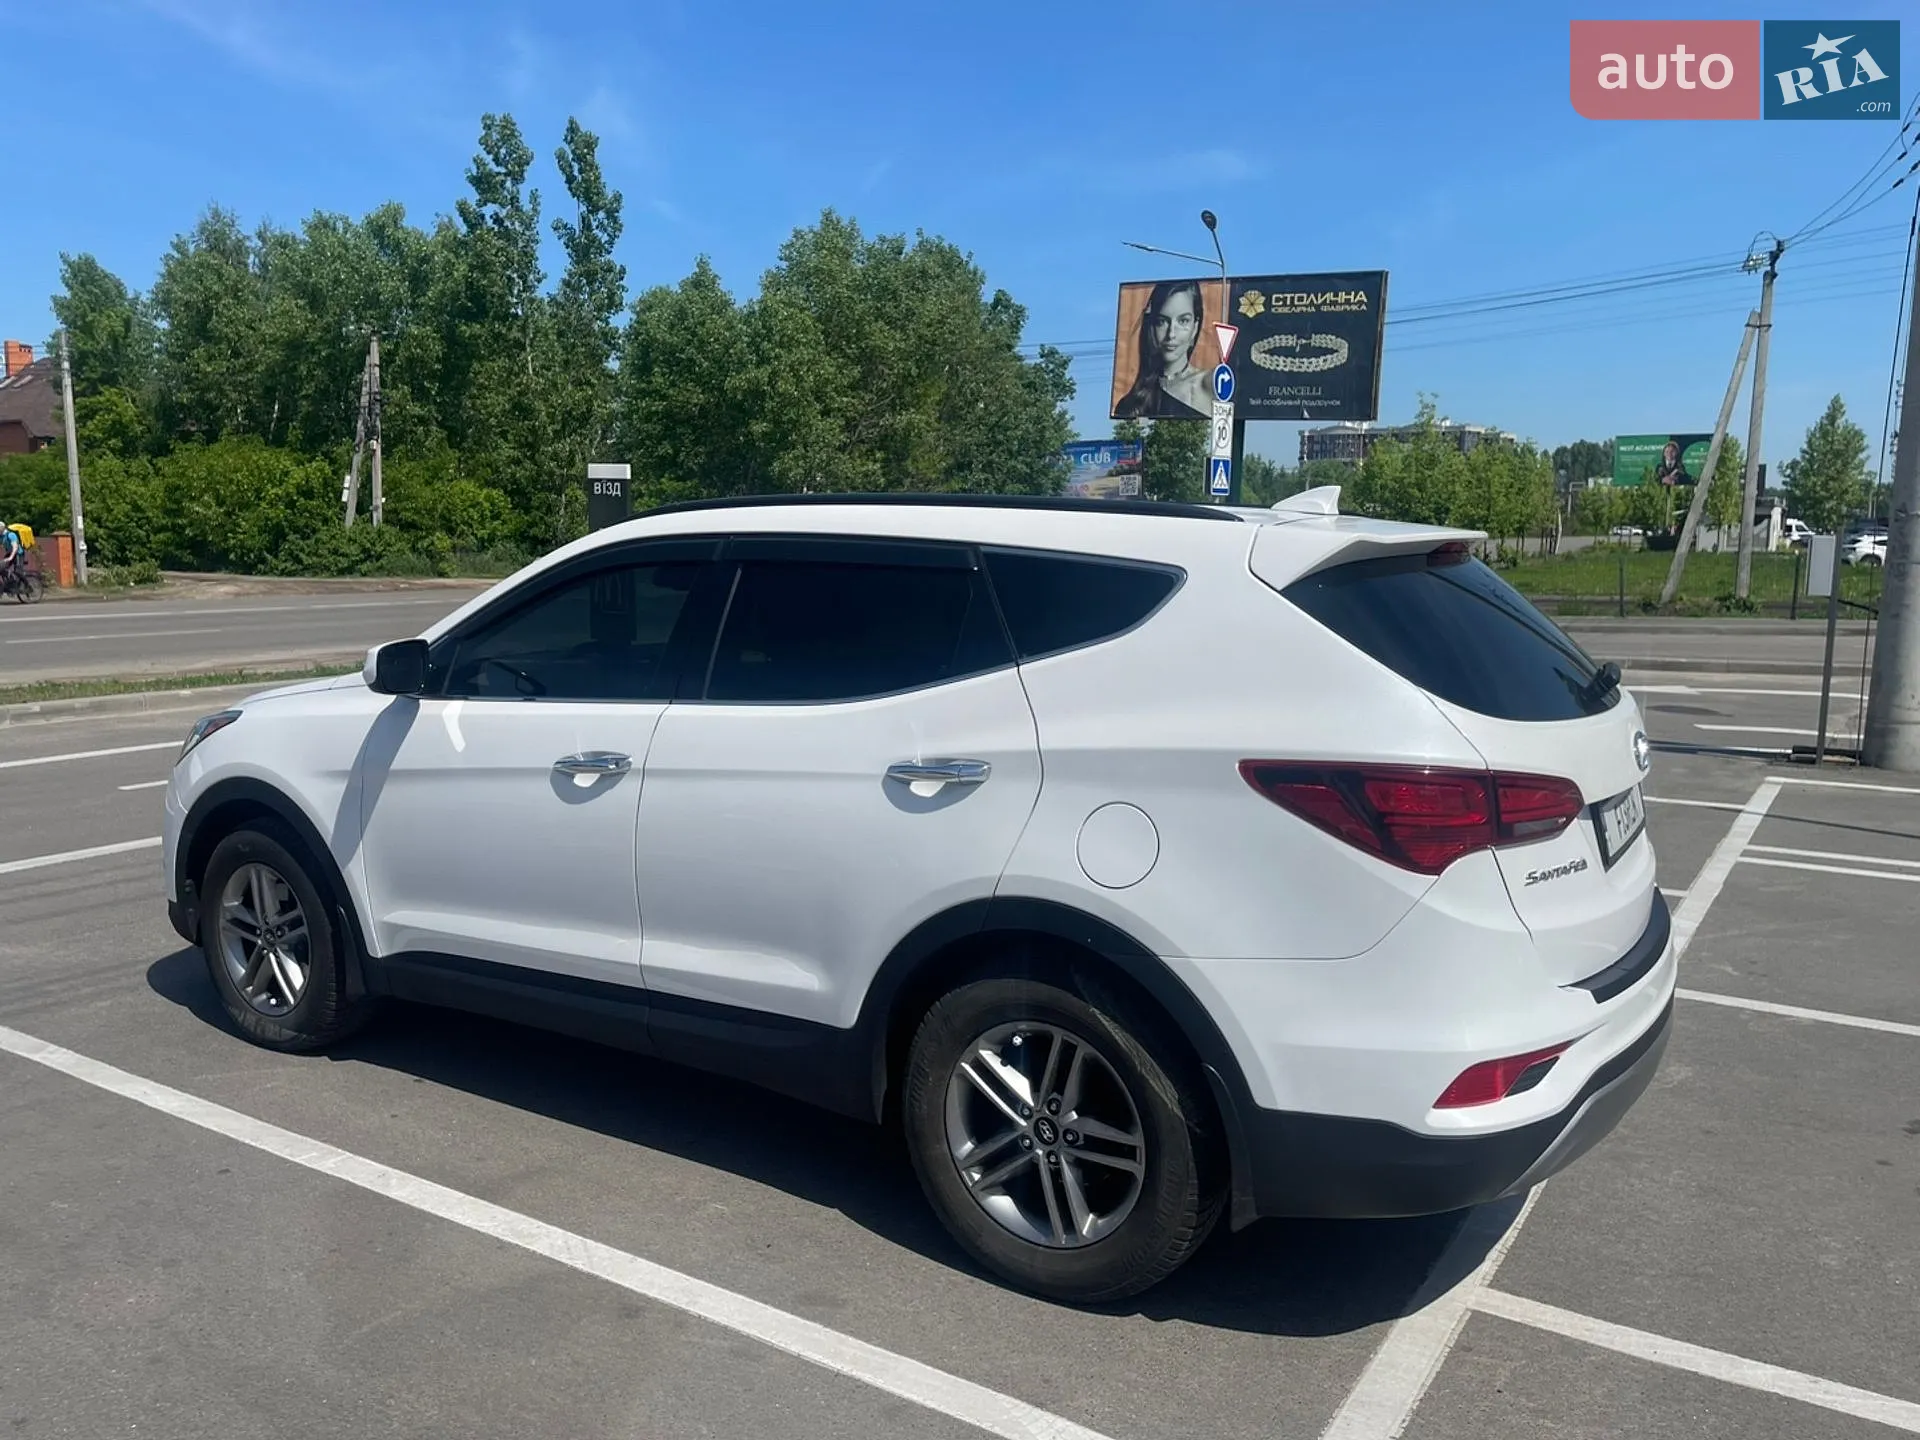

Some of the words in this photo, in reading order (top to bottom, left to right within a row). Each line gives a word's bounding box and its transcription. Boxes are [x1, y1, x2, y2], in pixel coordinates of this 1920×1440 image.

[1271, 290, 1368, 306] СТОЛИЧНА
[1268, 385, 1323, 396] FRANCELLI
[1081, 451, 1112, 465] CLUB
[593, 480, 621, 497] ВЇЗД
